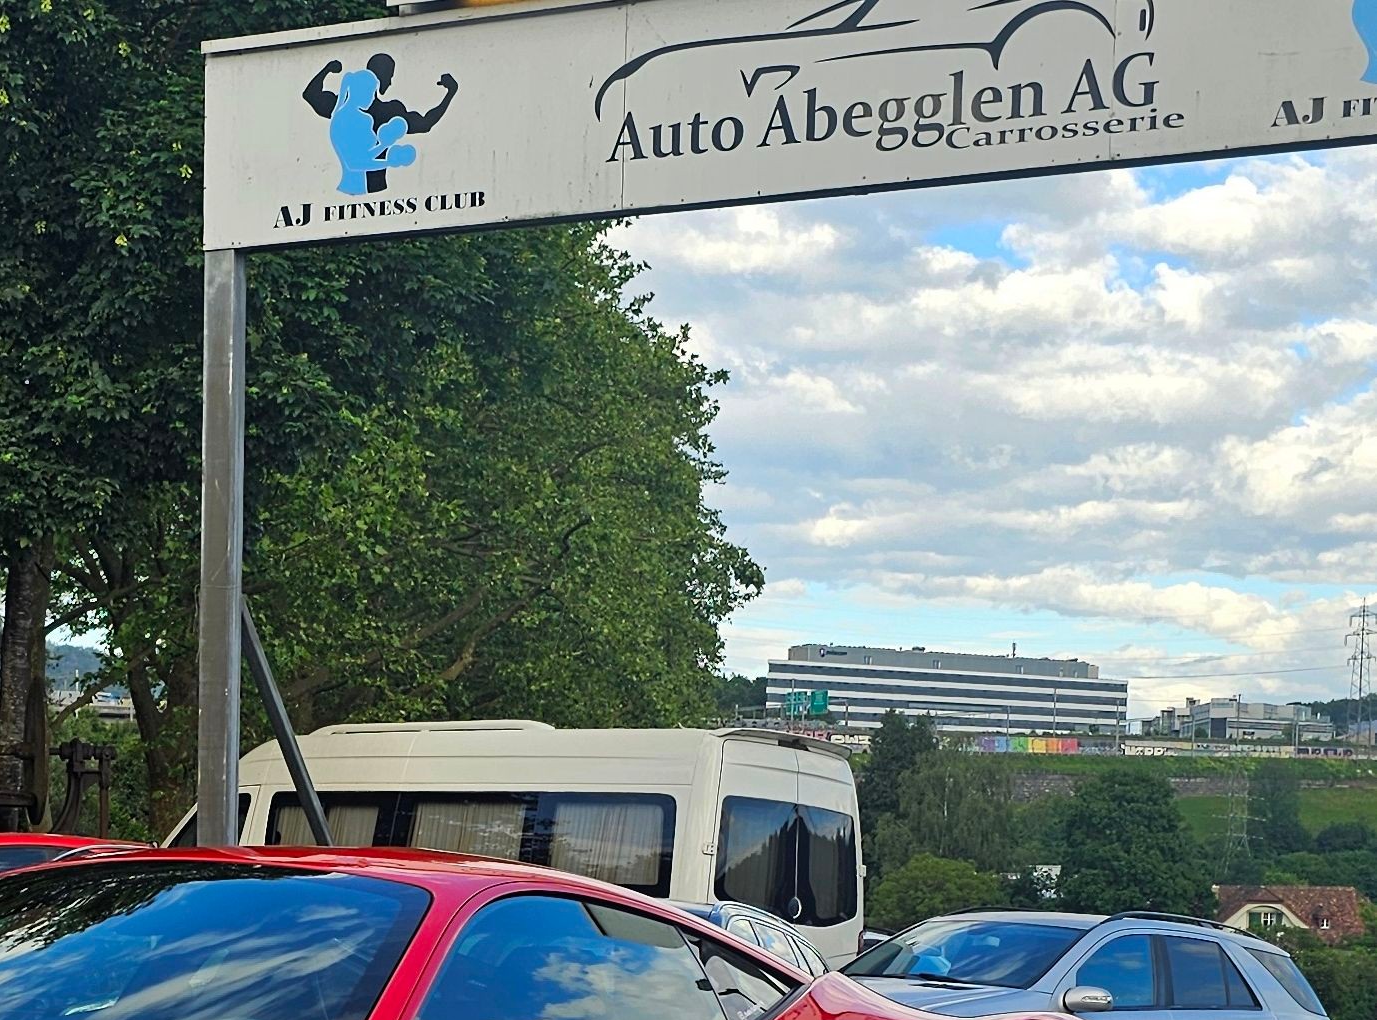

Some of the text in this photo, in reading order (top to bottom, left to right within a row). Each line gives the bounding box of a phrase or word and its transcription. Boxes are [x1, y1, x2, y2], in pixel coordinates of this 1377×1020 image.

[605, 52, 1161, 163] Auto Abegglen AG
[1270, 96, 1377, 127] AJ FI
[945, 108, 1185, 151] Carrosserie
[273, 190, 486, 229] AJ FITNESS CLUB
